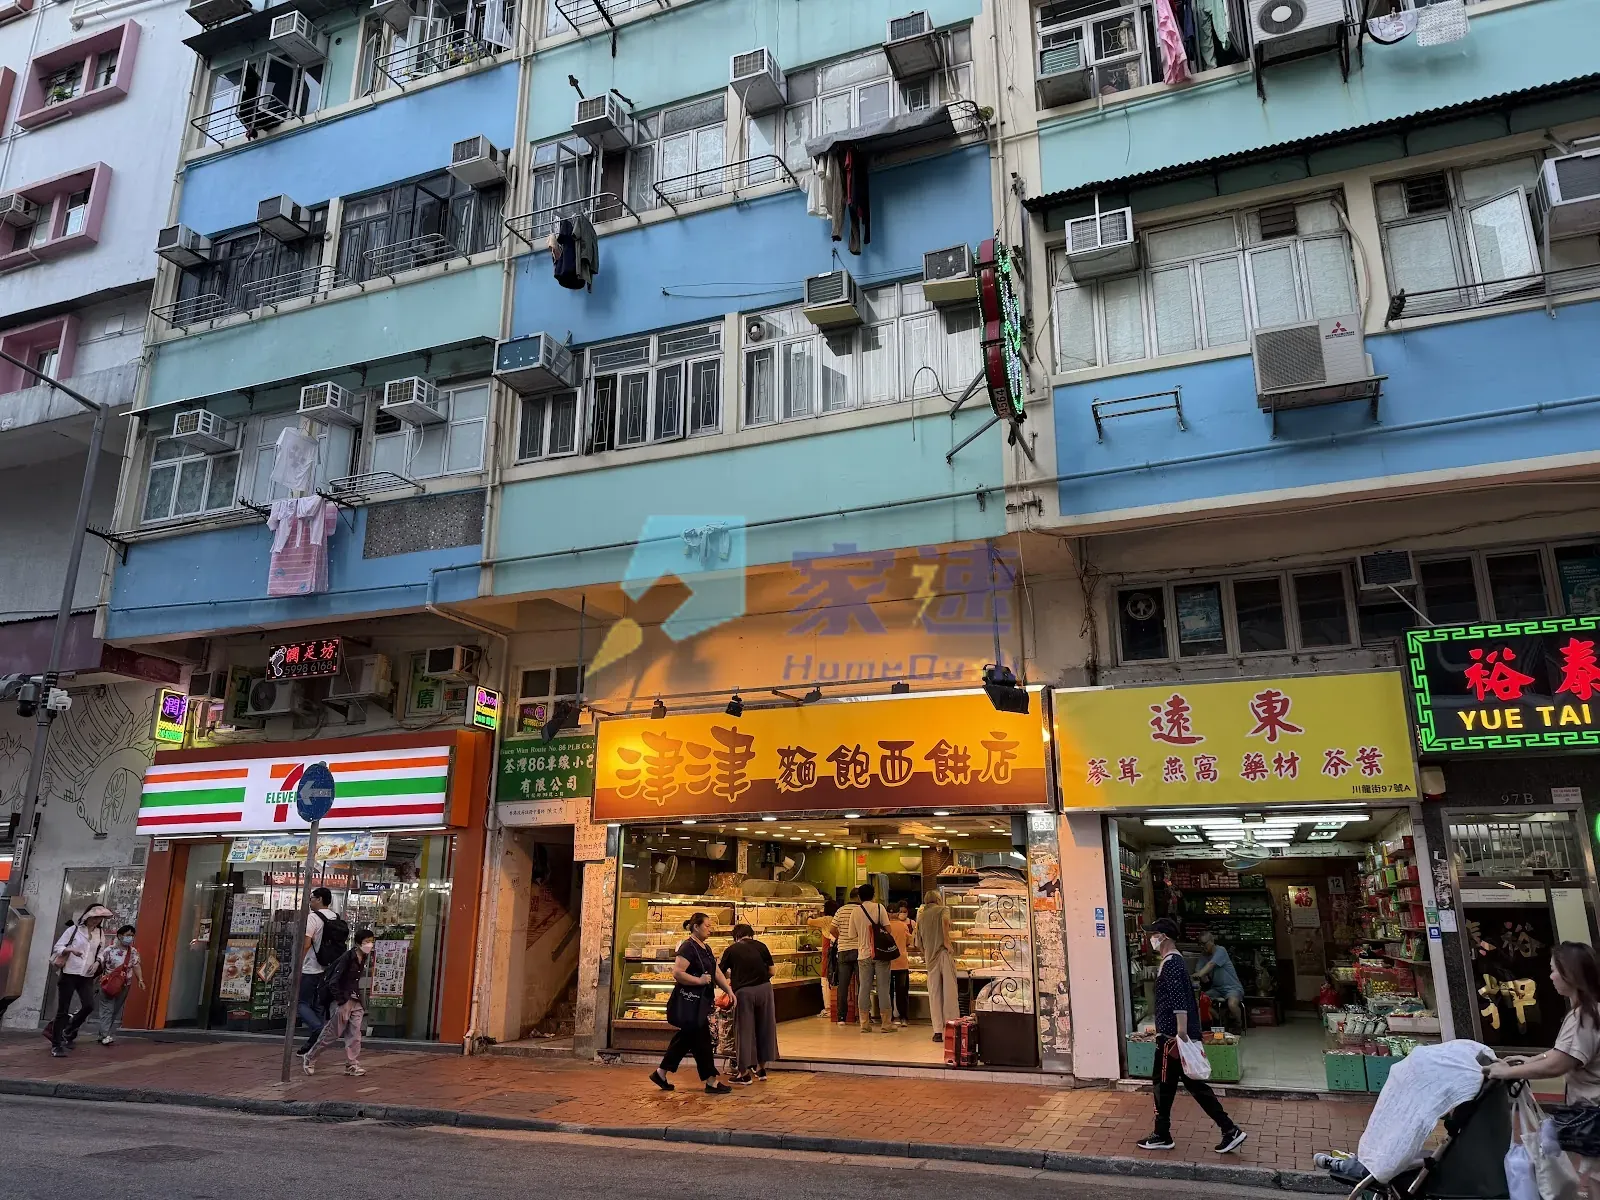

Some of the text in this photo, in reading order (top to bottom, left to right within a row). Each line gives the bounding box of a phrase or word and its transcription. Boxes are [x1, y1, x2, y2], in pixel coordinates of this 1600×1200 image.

[284, 660, 333, 675] 5998 6168
[1464, 637, 1600, 701] 裕泰
[1150, 688, 1304, 745] 遠東
[1458, 704, 1592, 731] YUE TAI
[615, 725, 756, 807] 津津
[1163, 753, 1218, 783] 燕窩
[1240, 750, 1299, 783] 藥材
[1321, 746, 1384, 778] 茶葉
[269, 762, 305, 823] 7
[520, 774, 577, 794] 有限公司
[1294, 887, 1314, 908] 福
[1330, 878, 1341, 889] 12
